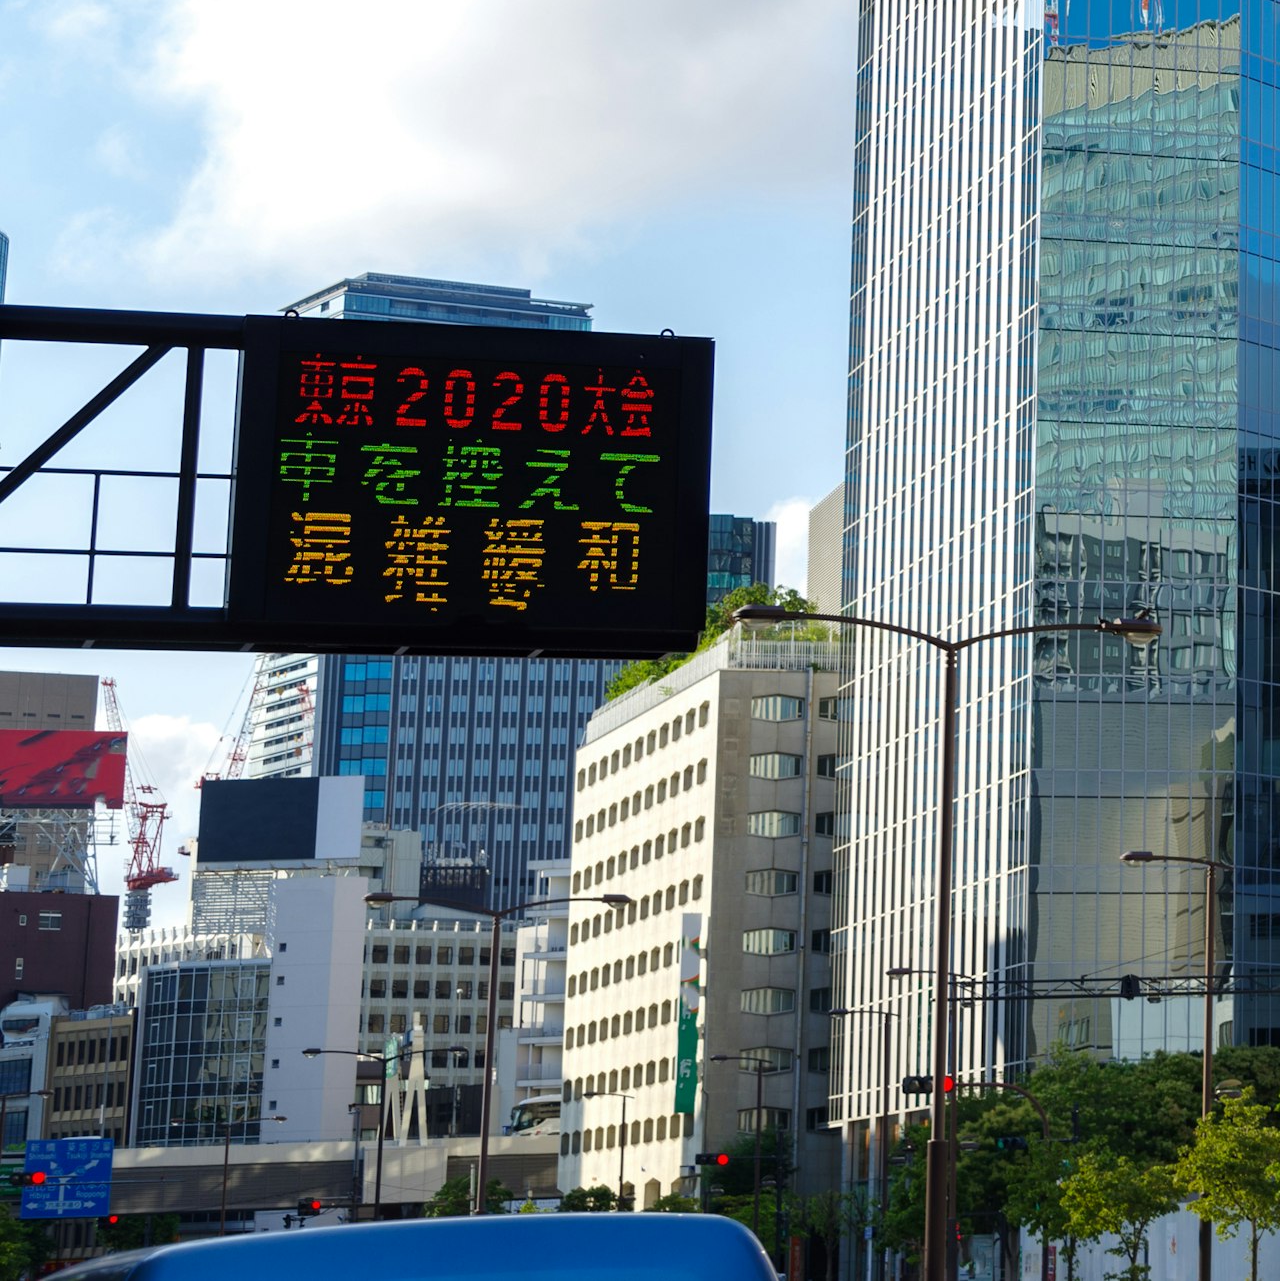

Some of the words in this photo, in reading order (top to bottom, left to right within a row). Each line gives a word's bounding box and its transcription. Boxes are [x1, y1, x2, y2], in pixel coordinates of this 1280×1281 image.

[294, 353, 655, 438] 東京2020大会
[280, 431, 661, 514] 車を控えて
[284, 511, 640, 612] 混雑緩和
